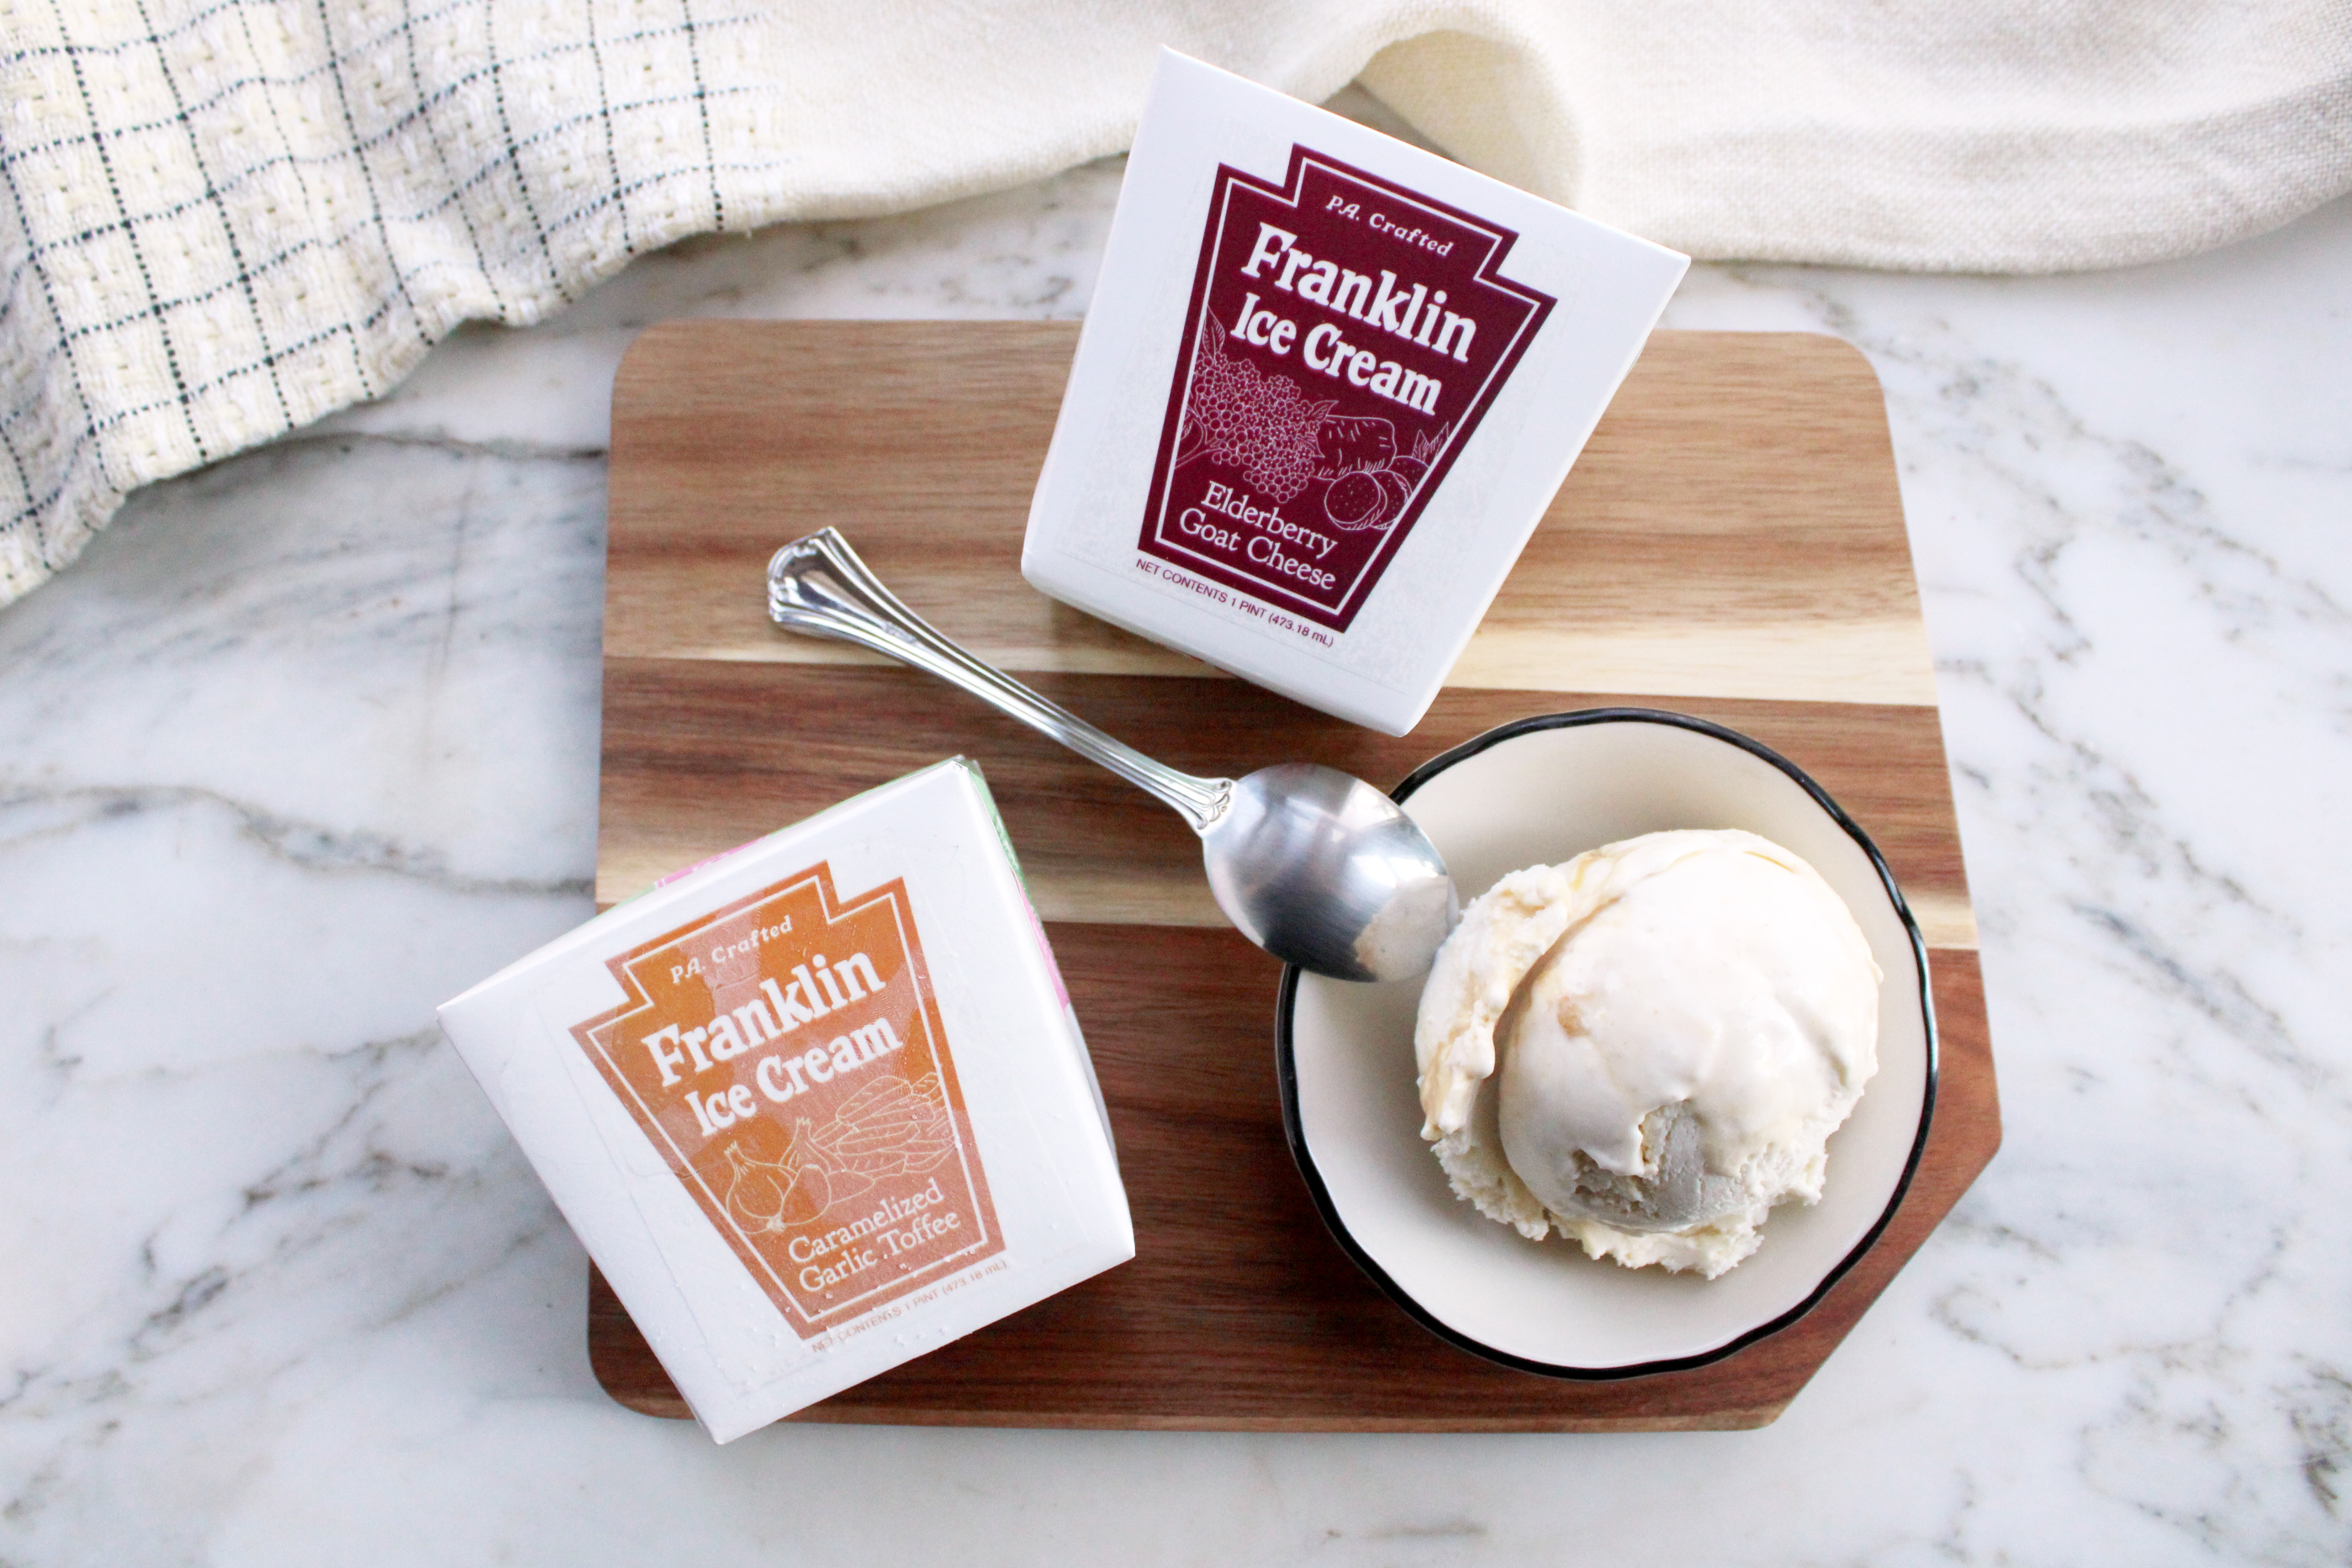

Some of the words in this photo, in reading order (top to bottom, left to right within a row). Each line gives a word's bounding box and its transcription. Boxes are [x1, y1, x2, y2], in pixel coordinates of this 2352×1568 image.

[1369, 213, 1454, 256] Crafted
[1240, 222, 1477, 362] Franklin
[1230, 293, 1296, 354] Ice
[1303, 323, 1443, 415] Cream
[1179, 509, 1240, 552] Goat
[1246, 536, 1336, 590] Cheese
[1201, 481, 1338, 559] Elderberry
[1136, 558, 1161, 576] NET
[1162, 569, 1228, 604] CONTENTS
[1231, 597, 1236, 607] 1
[1239, 600, 1267, 619] PINT
[1268, 612, 1310, 637] (473.18
[1312, 631, 1335, 648] mL)
[711, 915, 793, 964] Crafted
[641, 952, 885, 1086] Franklin
[684, 1081, 756, 1137] Ice
[756, 1017, 903, 1104] Cream
[788, 1178, 943, 1261] Caramelized
[799, 1247, 878, 1291] Garlic
[878, 1211, 960, 1256] Toffee
[838, 1306, 902, 1340] CONTENTS
[912, 1288, 940, 1307] PINT
[942, 1270, 983, 1296] (473.18
[984, 1259, 1007, 1276] mL)
